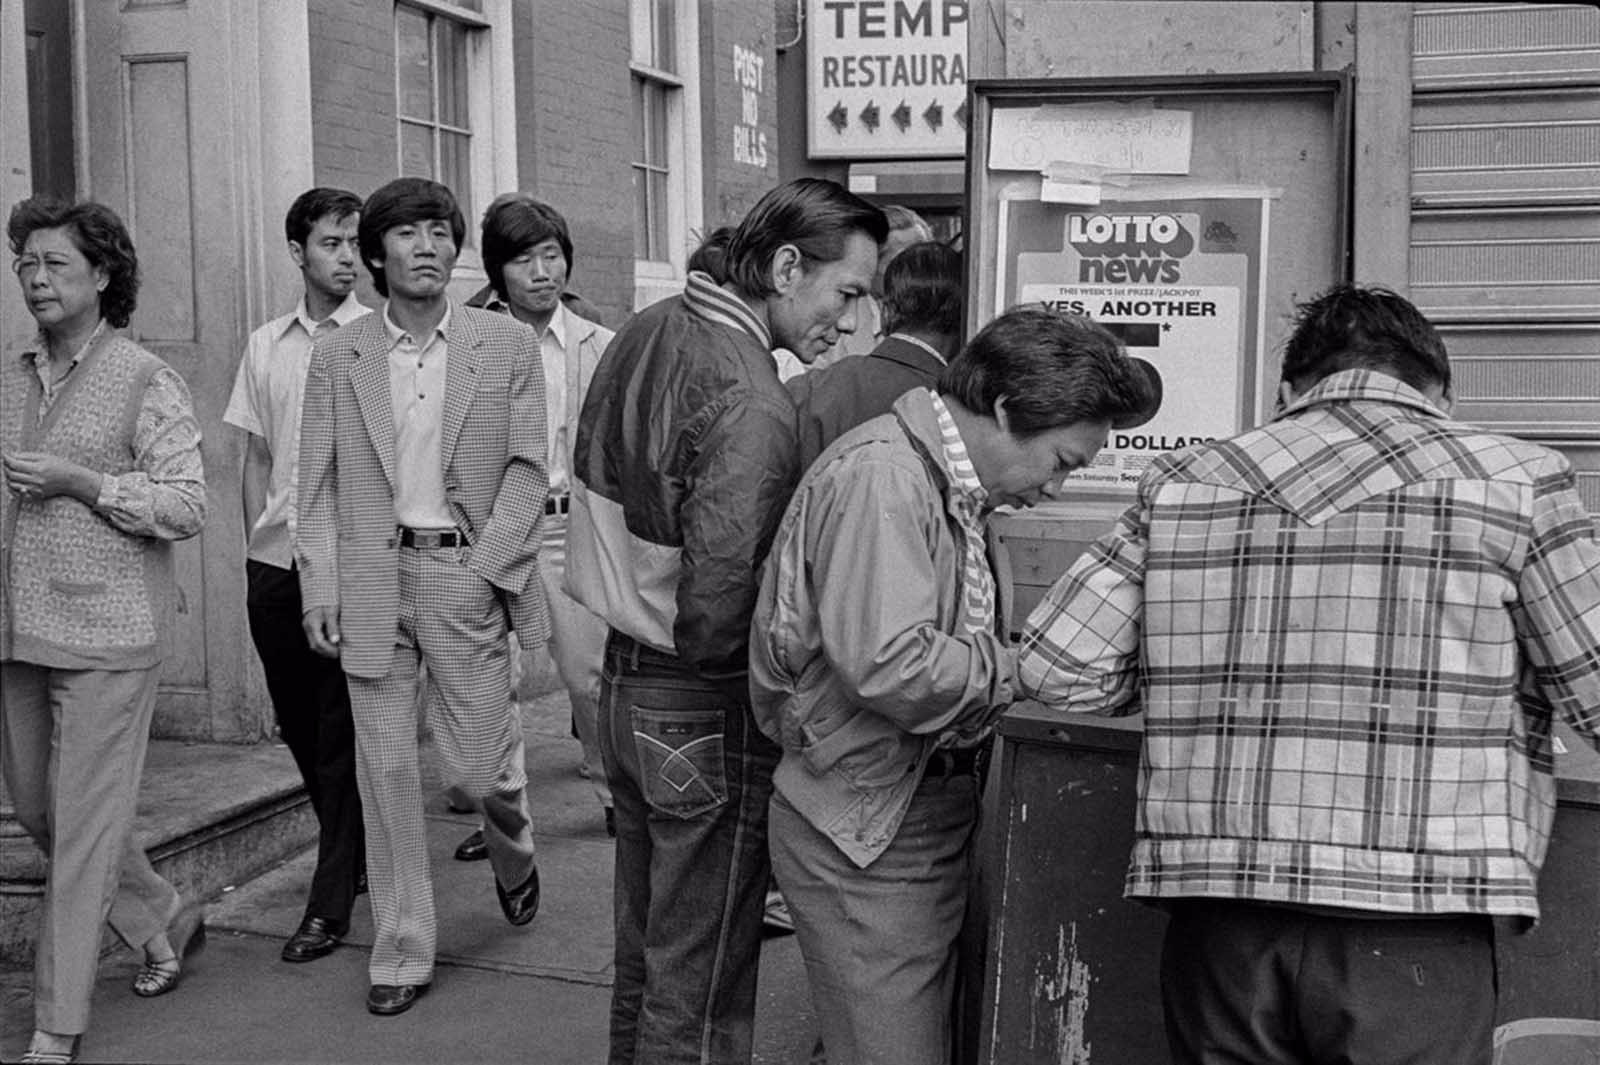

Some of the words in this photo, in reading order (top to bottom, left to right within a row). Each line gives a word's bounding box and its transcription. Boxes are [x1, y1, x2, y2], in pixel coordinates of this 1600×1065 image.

[824, 1, 967, 38] TEMP
[734, 45, 763, 92] POST
[823, 54, 966, 87] RESTAURA
[742, 88, 757, 126] NO
[734, 125, 767, 168] BILLS
[1069, 215, 1186, 250] LOTTO
[1079, 259, 1180, 284] news
[1040, 300, 1090, 317] YES,
[1100, 301, 1216, 316] ANOTHER
[1115, 435, 1217, 451] DOLLA
